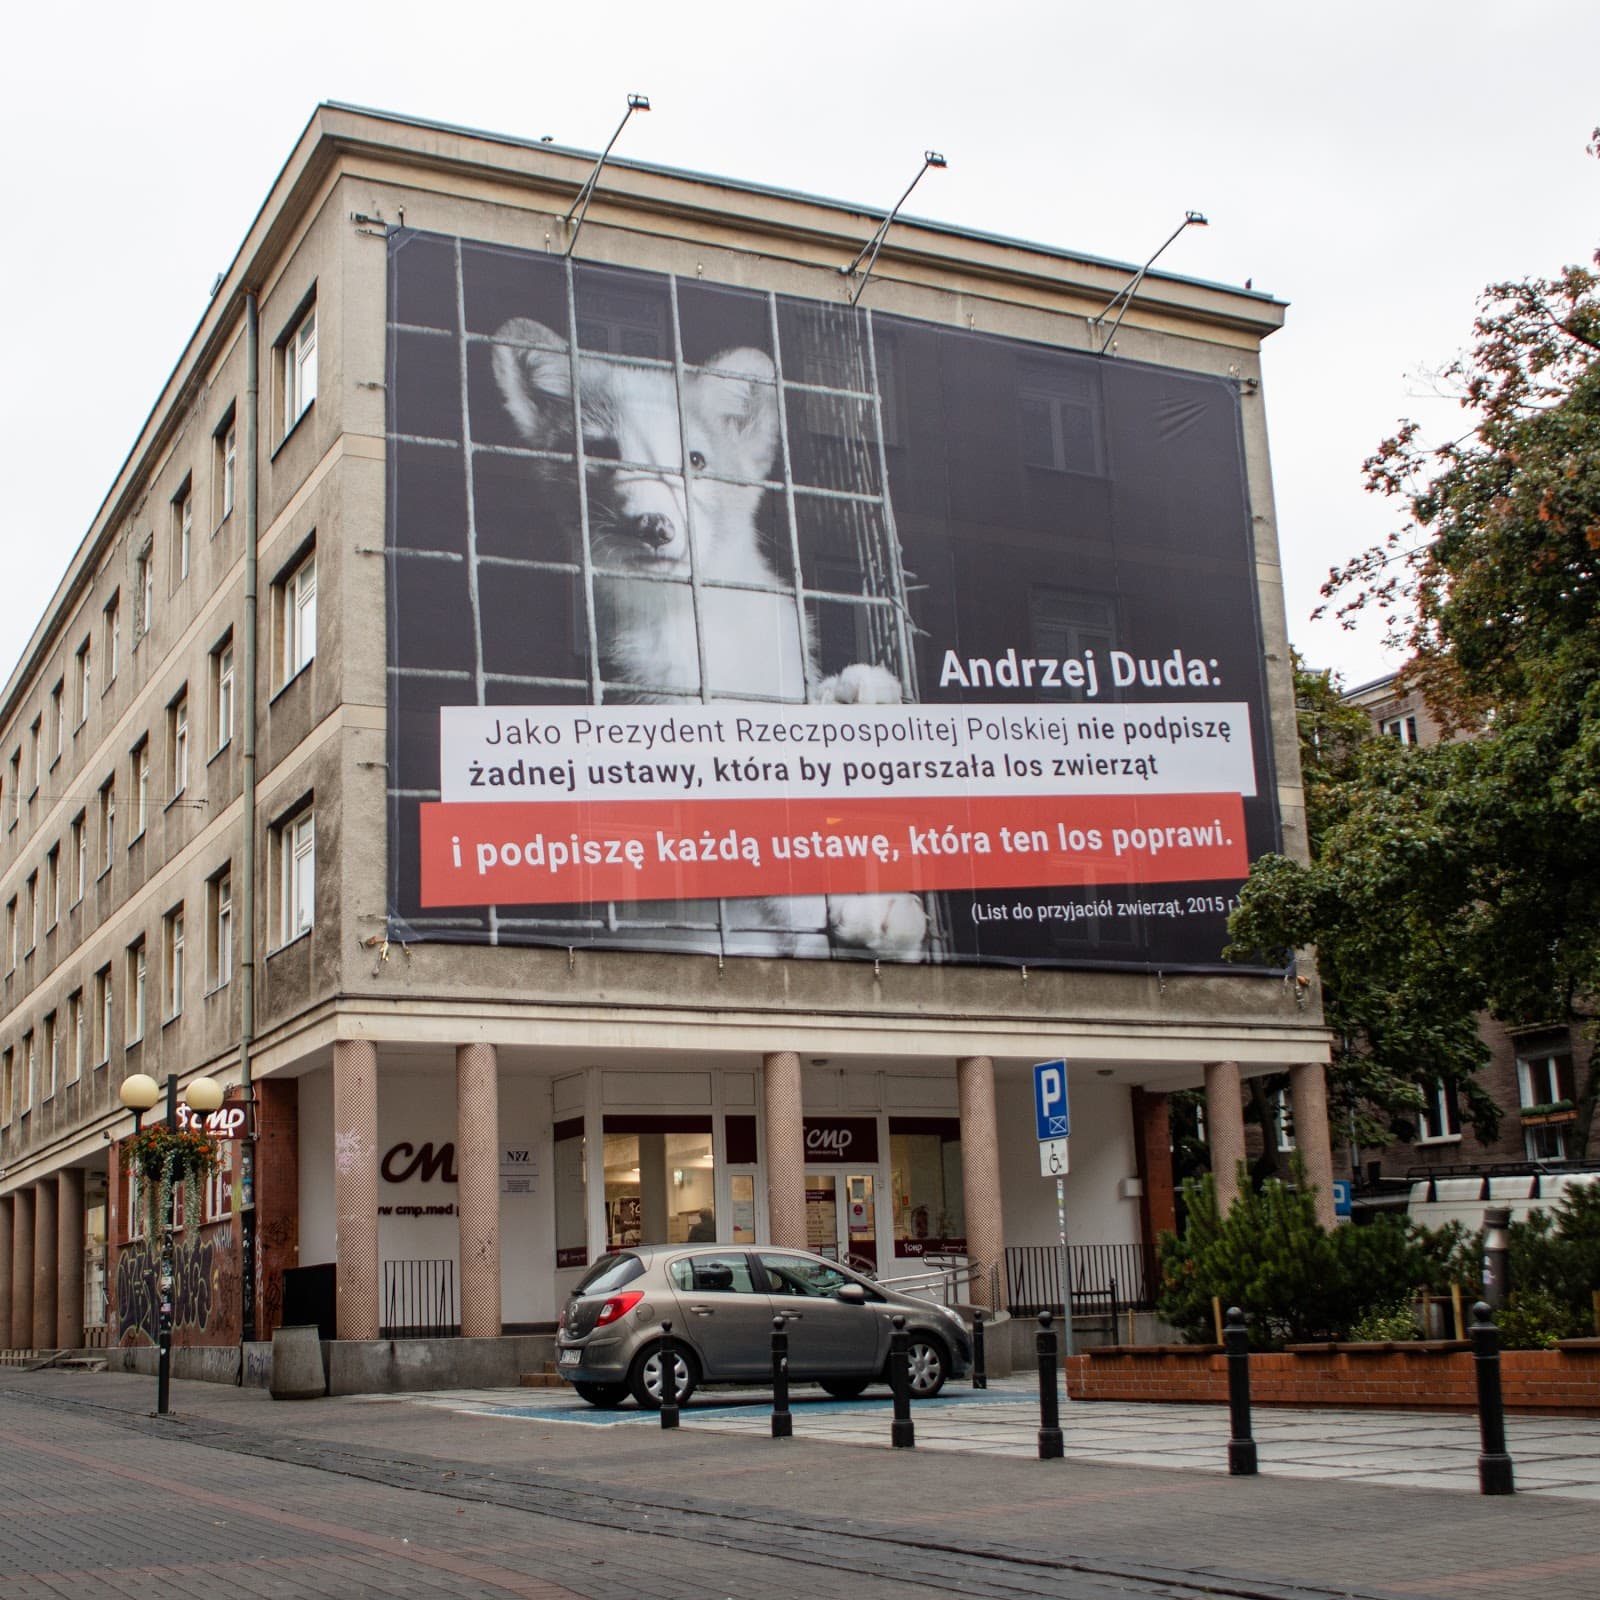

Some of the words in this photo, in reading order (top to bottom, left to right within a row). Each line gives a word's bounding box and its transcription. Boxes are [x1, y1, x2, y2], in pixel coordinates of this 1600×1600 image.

[939, 649, 1098, 697] Andrzej
[1110, 649, 1221, 688] Duda:
[486, 718, 561, 746] Jako
[574, 717, 725, 750] Prezydent
[737, 715, 958, 747] Rzeczpospolitej
[968, 716, 1068, 746] Polskiej
[1078, 717, 1115, 740] nie
[1124, 715, 1232, 745] podpiszę
[469, 760, 576, 791] żadnej
[588, 758, 704, 789] ustawy,
[713, 756, 789, 782] która
[800, 755, 831, 786] by
[844, 754, 995, 786] pogarszała
[1004, 753, 1042, 778] los
[1052, 753, 1159, 781] zwierząt
[451, 836, 463, 868] i
[476, 833, 645, 875] podpiszę
[656, 829, 761, 868] każdą
[772, 831, 900, 863] ustawę,
[908, 824, 990, 855] która
[999, 826, 1049, 852] ten
[1058, 822, 1102, 851] los
[1113, 819, 1233, 855] poprawi.
[971, 901, 1009, 924] (List
[1012, 902, 1034, 921] do
[1037, 899, 1113, 923] przyjaciół
[1116, 898, 1185, 918] zwierząt,
[1187, 896, 1225, 914] 2015
[1041, 1068, 1061, 1117] P
